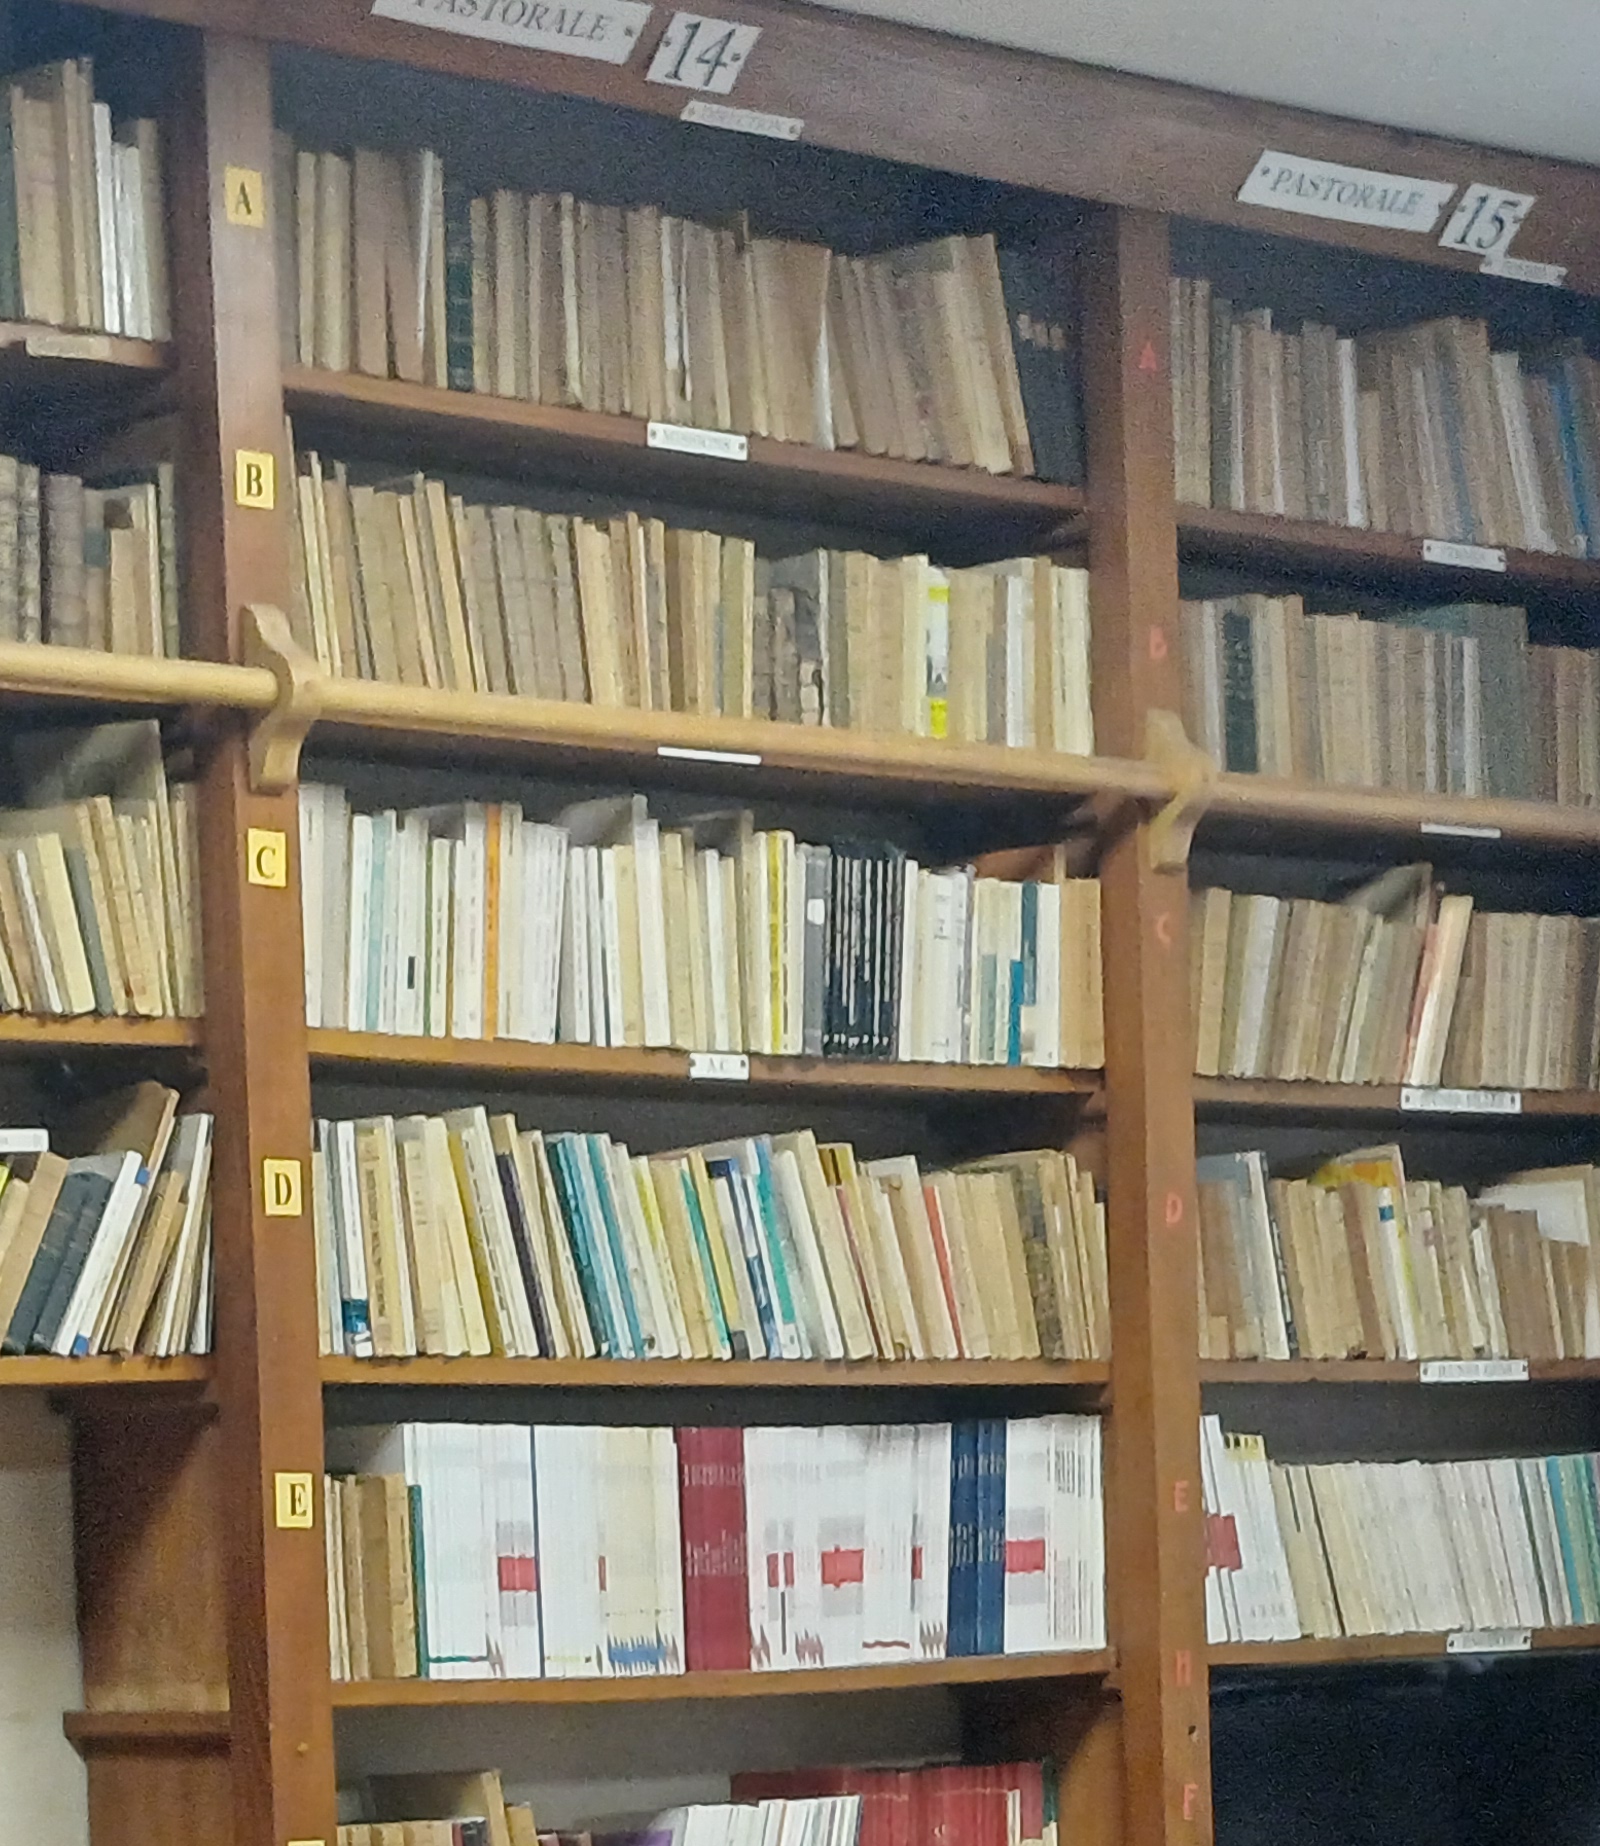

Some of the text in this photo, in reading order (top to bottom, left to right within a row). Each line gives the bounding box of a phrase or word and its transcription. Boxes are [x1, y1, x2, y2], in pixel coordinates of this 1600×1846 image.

[412, 0, 612, 41] ASTORALE
[665, 20, 736, 87] 14
[235, 180, 253, 215] A
[1270, 167, 1424, 215] PASTORALE
[1455, 195, 1521, 249] 15
[245, 463, 263, 498] B
[256, 845, 278, 880] C
[274, 1172, 293, 1205] D
[1165, 1193, 1183, 1224] D
[289, 1483, 307, 1517] E
[1174, 1480, 1189, 1512] E
[1182, 1783, 1199, 1820] F
